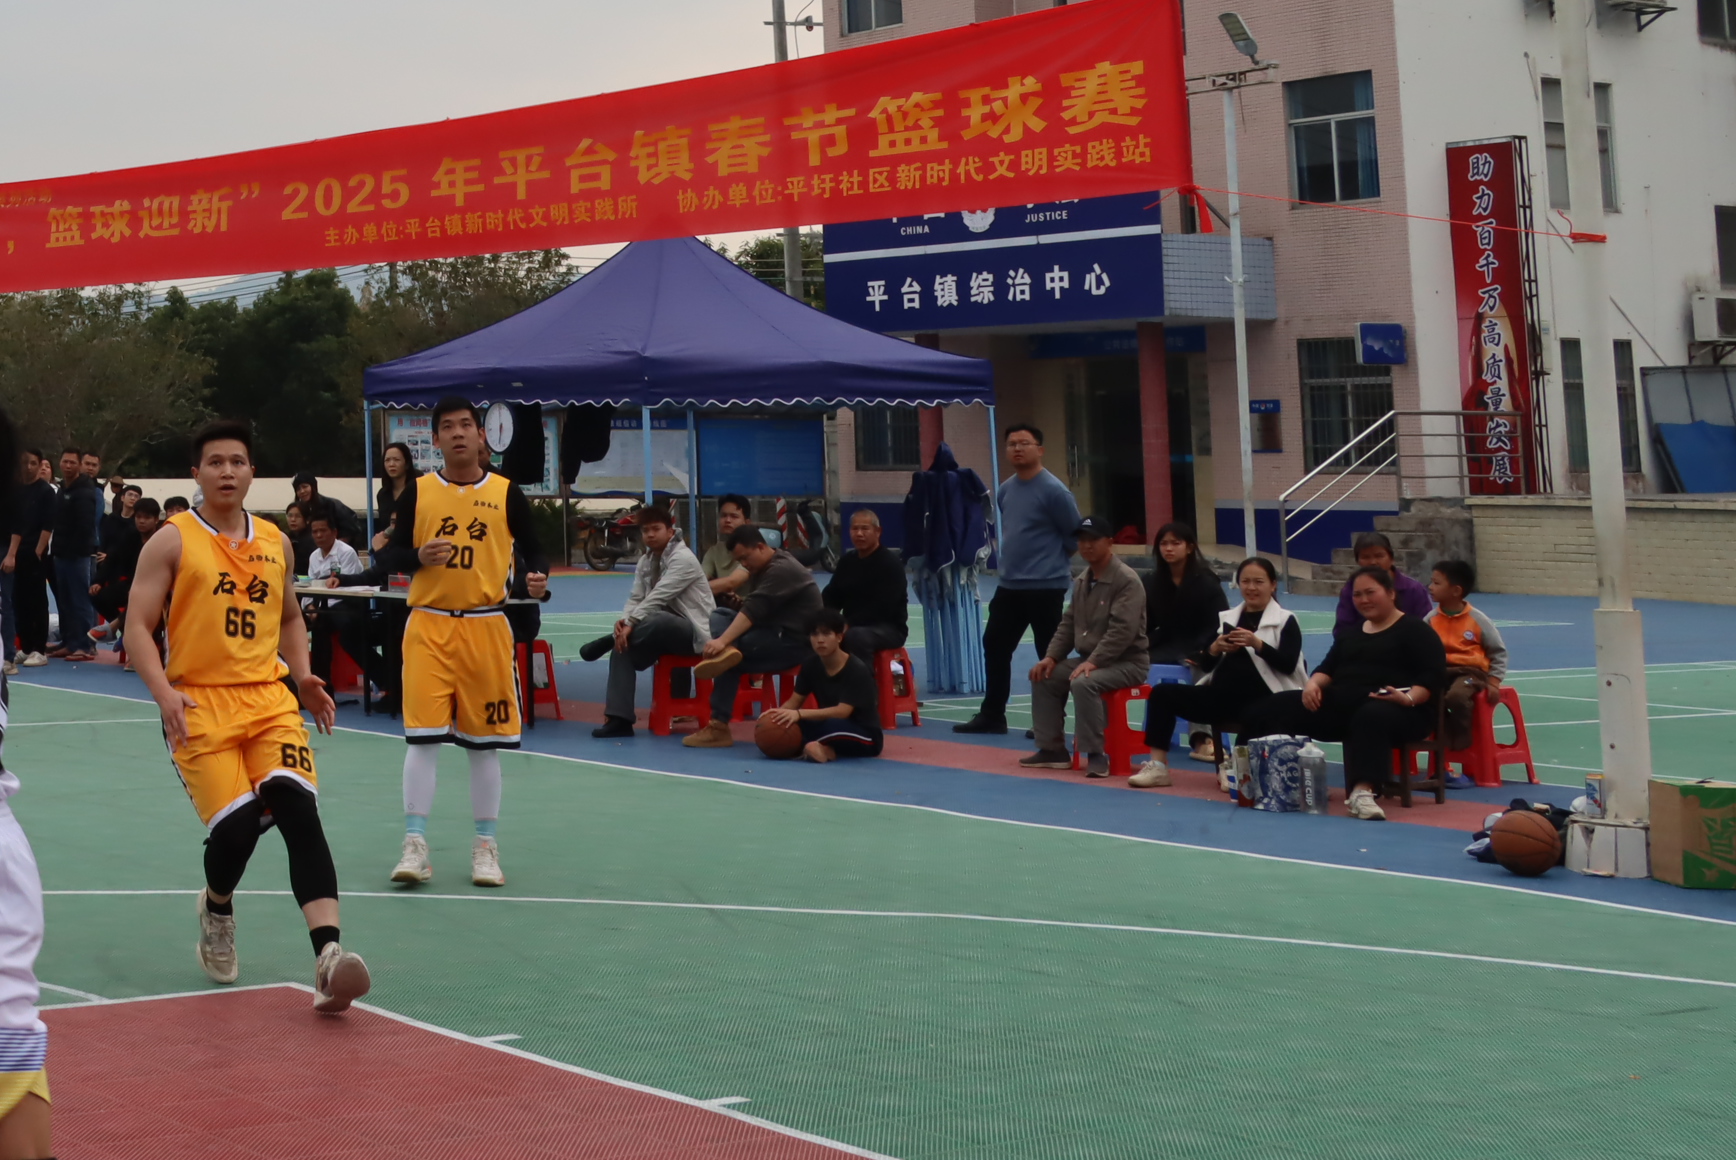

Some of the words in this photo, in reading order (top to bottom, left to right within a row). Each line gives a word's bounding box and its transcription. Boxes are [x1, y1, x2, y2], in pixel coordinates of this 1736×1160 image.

[900, 224, 930, 236] CHINA
[1024, 210, 1068, 223] JUSTICE
[866, 262, 1111, 312] 平台镇综治中心
[1467, 152, 1515, 485] 助力百千万高质量发展
[435, 515, 488, 542] 石台
[445, 544, 474, 570] 20
[212, 571, 269, 605] 石台
[225, 605, 256, 641] 66
[485, 699, 510, 725] 20
[281, 742, 313, 773] 66
[1305, 787, 1313, 806] CUP
